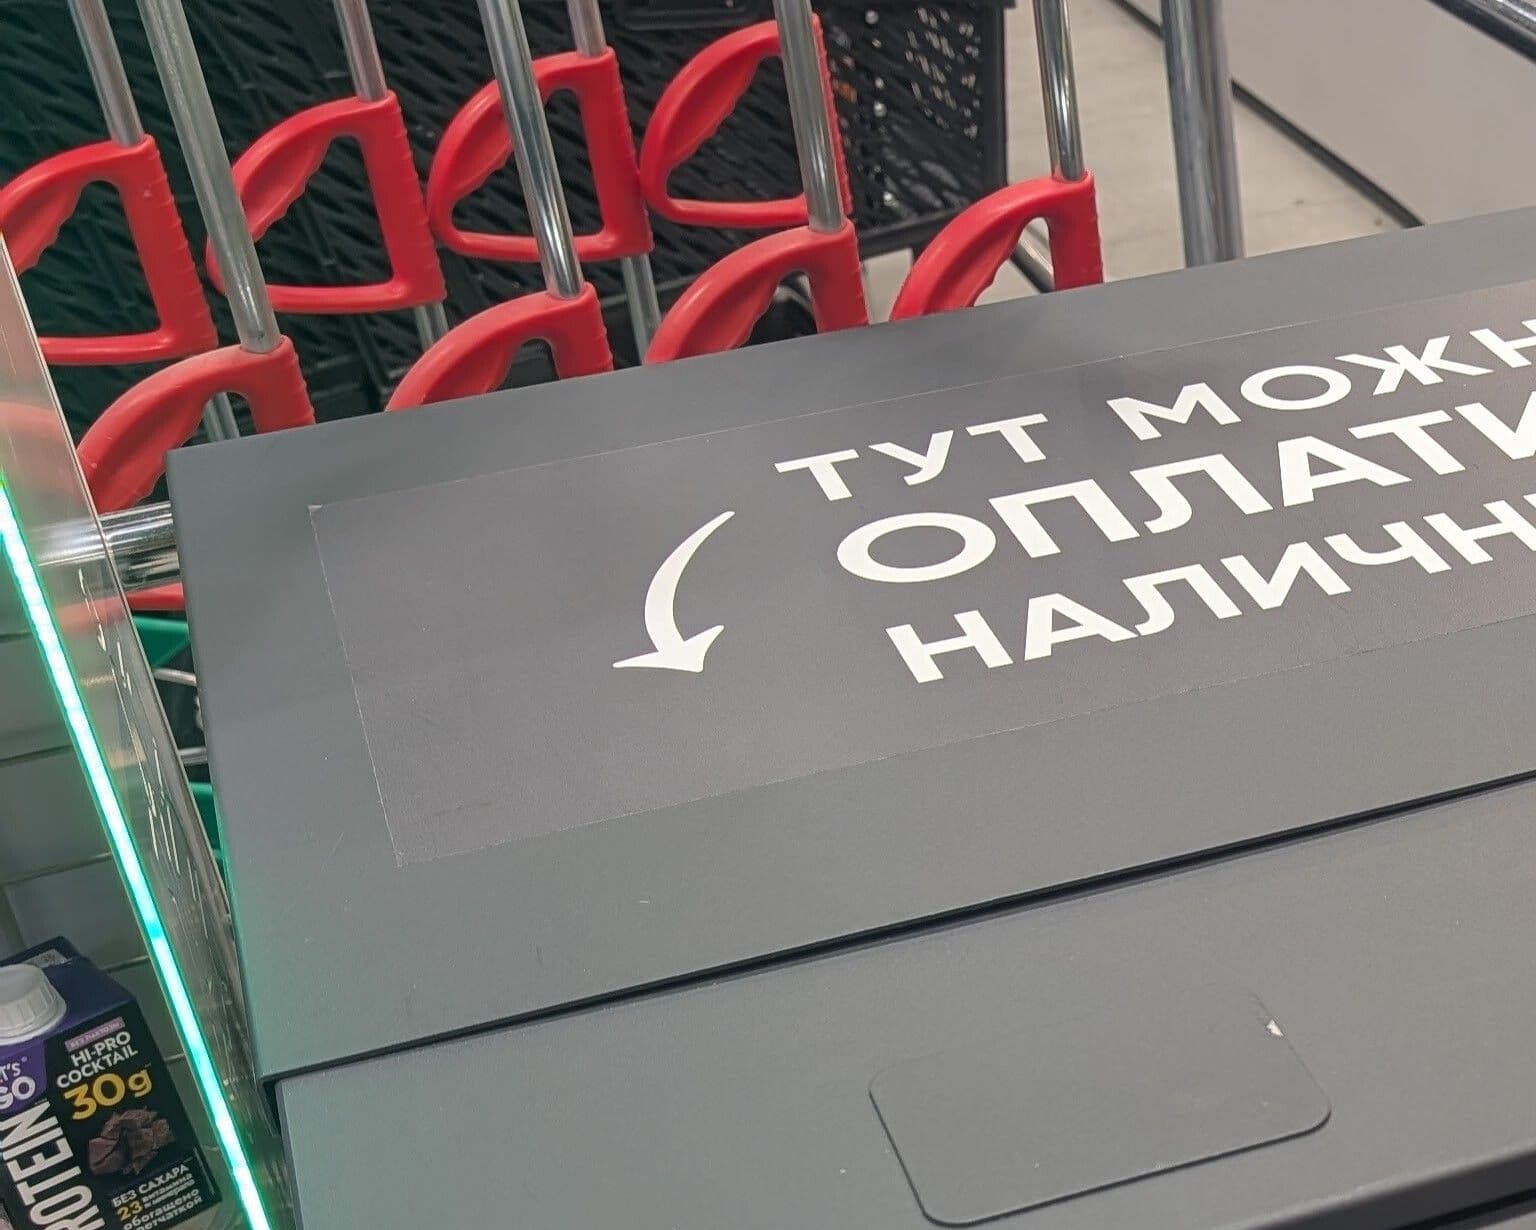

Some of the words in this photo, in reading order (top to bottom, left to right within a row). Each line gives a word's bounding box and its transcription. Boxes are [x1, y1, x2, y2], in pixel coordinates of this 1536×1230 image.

[775, 414, 1048, 501] ТУТ
[56, 1045, 138, 1089] COCKTAIL
[71, 1031, 131, 1067] HI-PRO
[64, 1069, 153, 1121] 30g
[111, 1188, 137, 1208] БЕЗ
[138, 1164, 190, 1193] САХАРА
[116, 1203, 144, 1222] 23
[123, 1188, 200, 1230] обогащено
